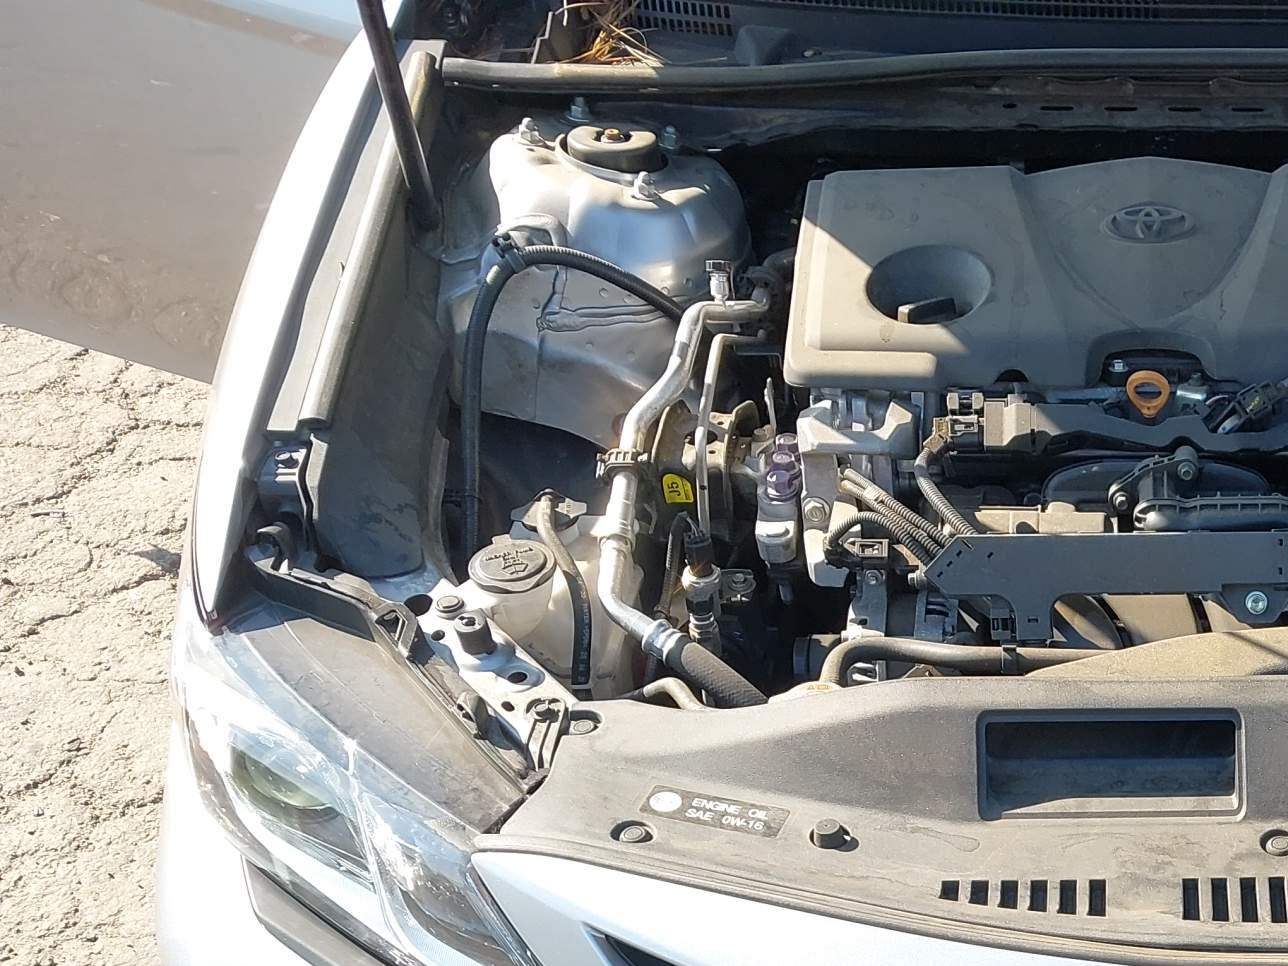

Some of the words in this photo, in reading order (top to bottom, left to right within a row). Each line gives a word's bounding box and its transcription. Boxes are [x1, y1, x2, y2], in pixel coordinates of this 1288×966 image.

[667, 481, 681, 497] J5
[685, 809, 714, 821] SAE
[721, 815, 765, 830] 0W-16
[691, 798, 741, 815] ENGINE
[748, 808, 769, 820] OIL
